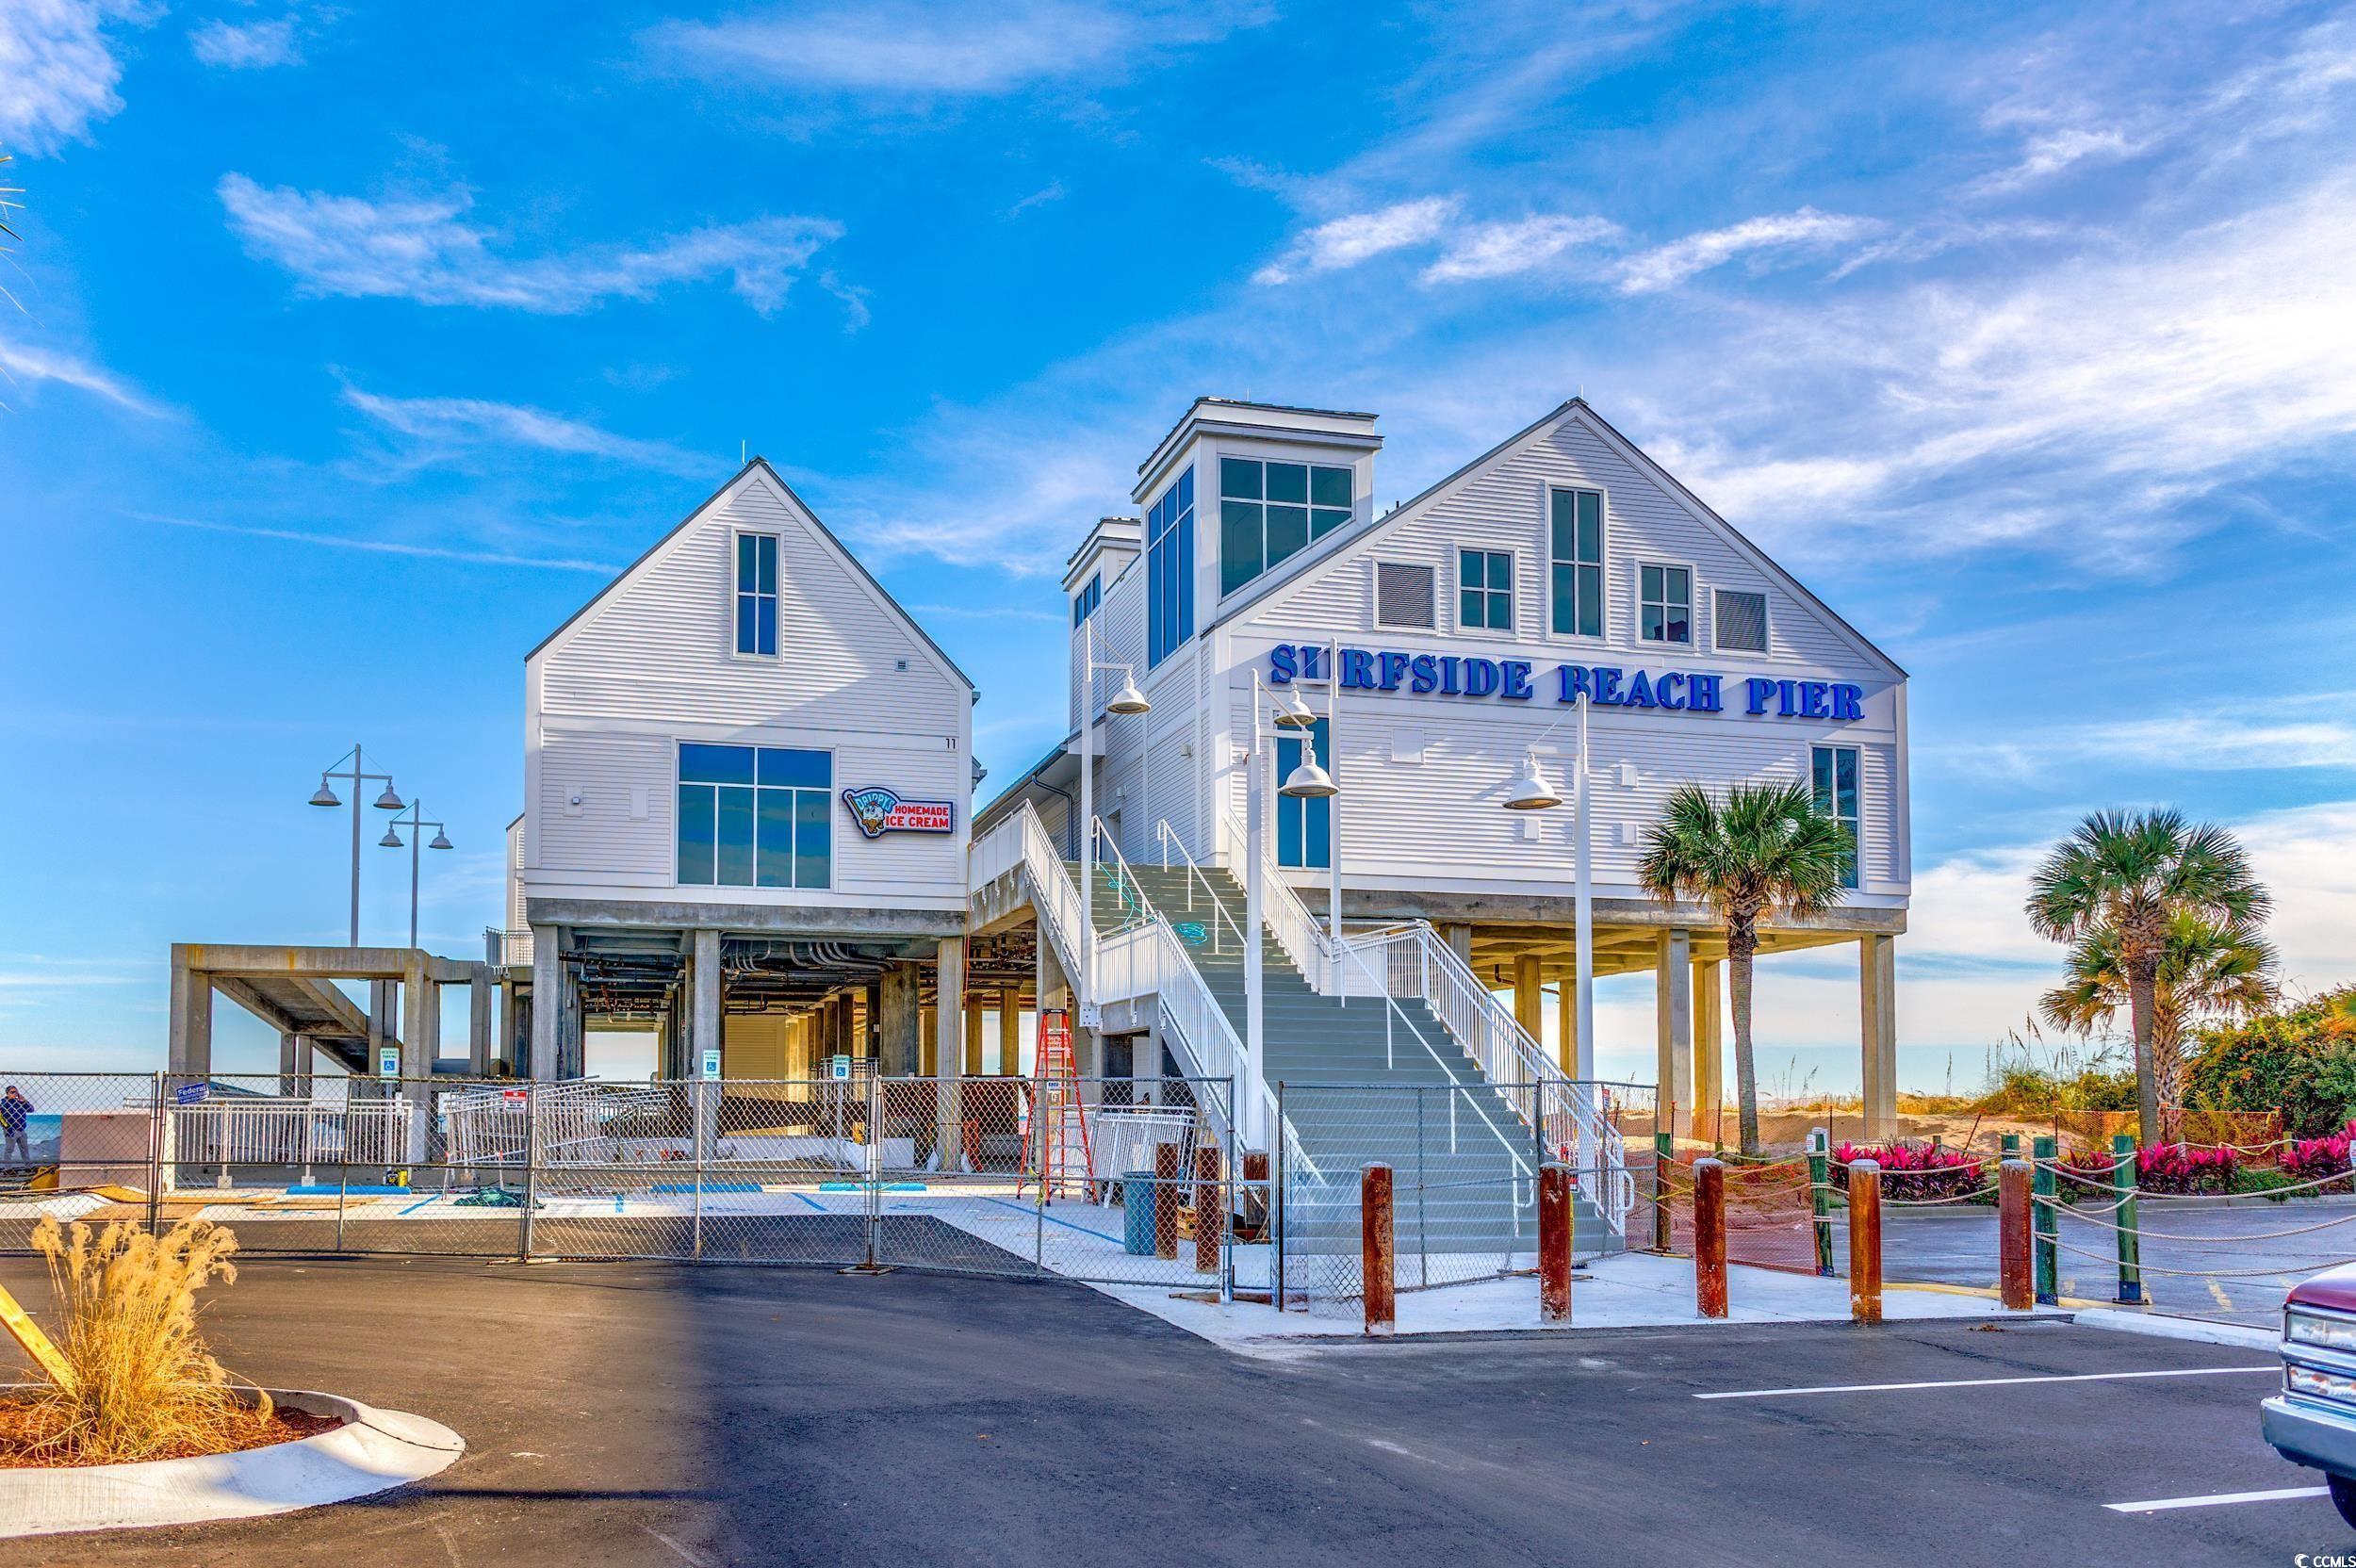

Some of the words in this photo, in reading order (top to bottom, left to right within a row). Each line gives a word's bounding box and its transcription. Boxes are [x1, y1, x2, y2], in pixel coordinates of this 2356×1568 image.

[1271, 644, 1533, 700] SURFSIDE
[1558, 665, 1724, 712] BEACH
[1745, 677, 1865, 721] PIER
[945, 738, 956, 749] 11
[895, 806, 949, 816] HOMEMADE
[886, 816, 905, 826] ICE
[908, 816, 949, 827] CREAM
[177, 1085, 206, 1097] Federal
